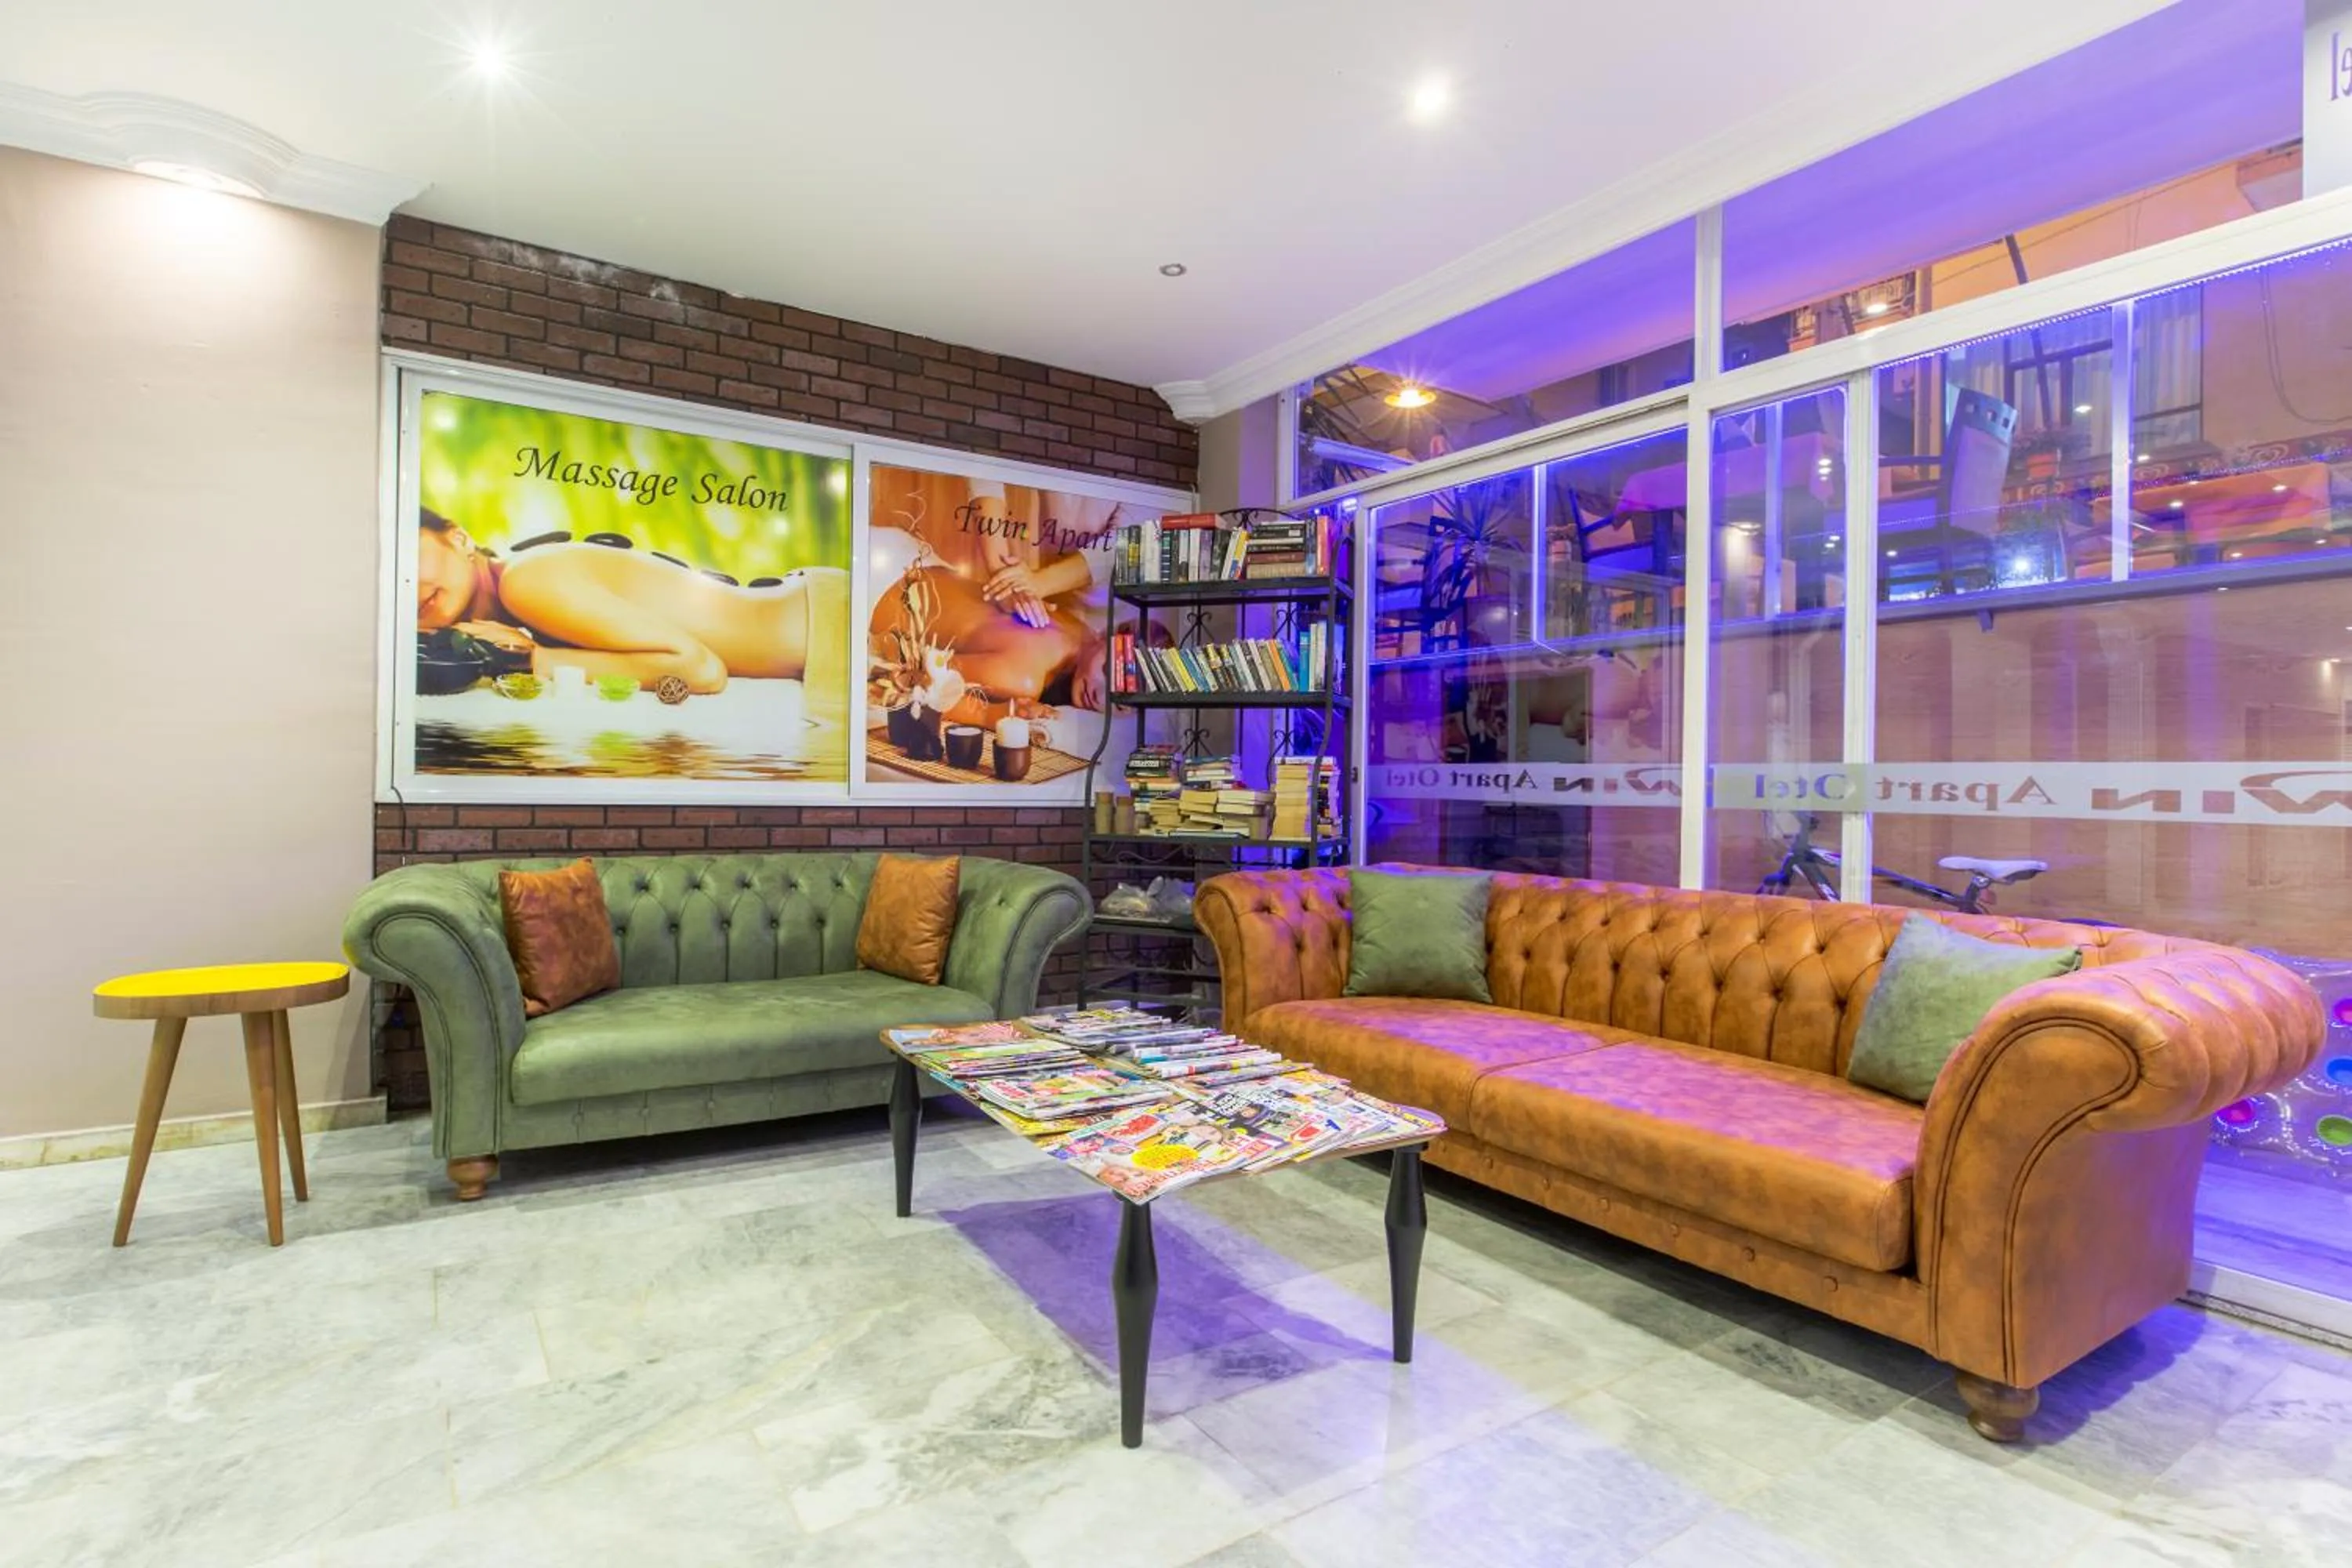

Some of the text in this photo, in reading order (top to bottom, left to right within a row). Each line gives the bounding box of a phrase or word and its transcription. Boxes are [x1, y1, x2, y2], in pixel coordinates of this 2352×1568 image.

[514, 447, 788, 511] Massage Salon
[954, 505, 1112, 555] Twin Apart
